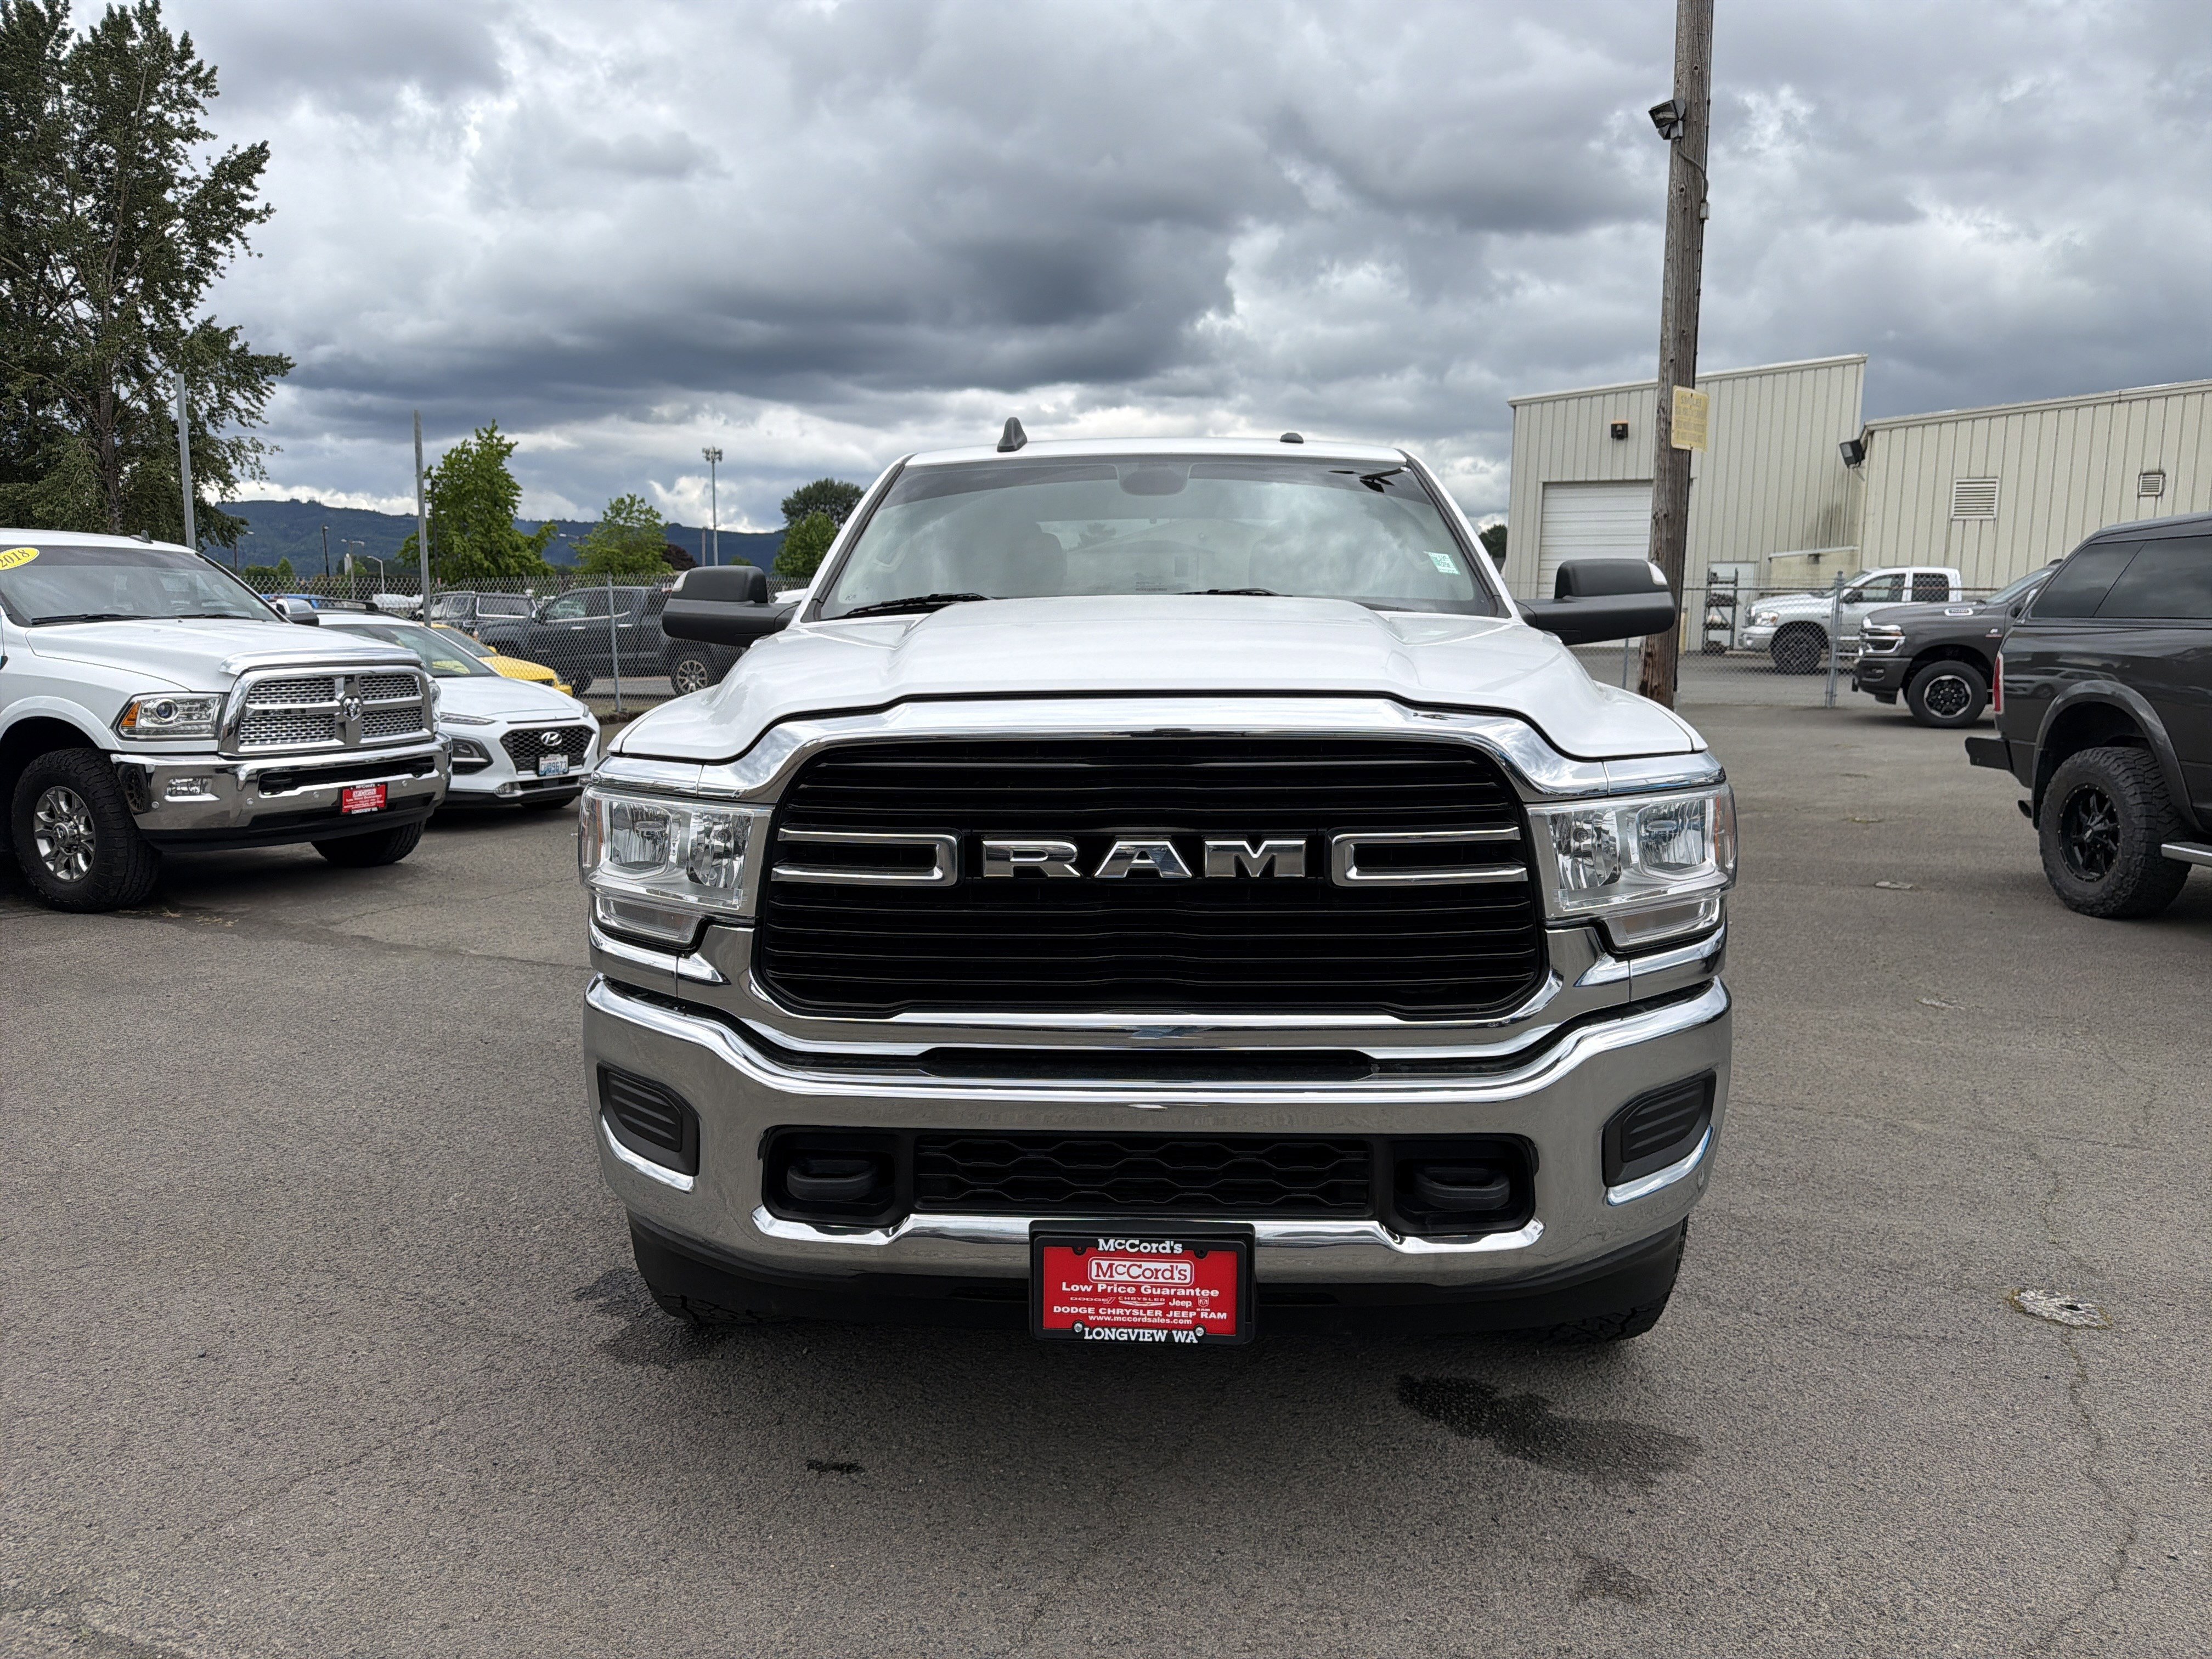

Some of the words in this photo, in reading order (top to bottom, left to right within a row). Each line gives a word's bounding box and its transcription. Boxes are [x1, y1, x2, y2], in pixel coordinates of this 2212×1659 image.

[0, 549, 30, 568] 2018
[981, 838, 1307, 878] RAM
[1098, 1238, 1183, 1254] McCord's
[1094, 1262, 1188, 1280] McCord's
[1062, 1282, 1093, 1292] Low
[1097, 1283, 1136, 1294] Price
[1141, 1285, 1220, 1297] Guarantee
[1169, 1298, 1192, 1308] Jeep
[1053, 1306, 1095, 1314] DODGE
[1099, 1307, 1163, 1317] CHRYSLER
[1088, 1315, 1192, 1324] www.mccordsales.com
[1084, 1327, 1168, 1342] LONGVIEW
[1172, 1330, 1198, 1344] WA
